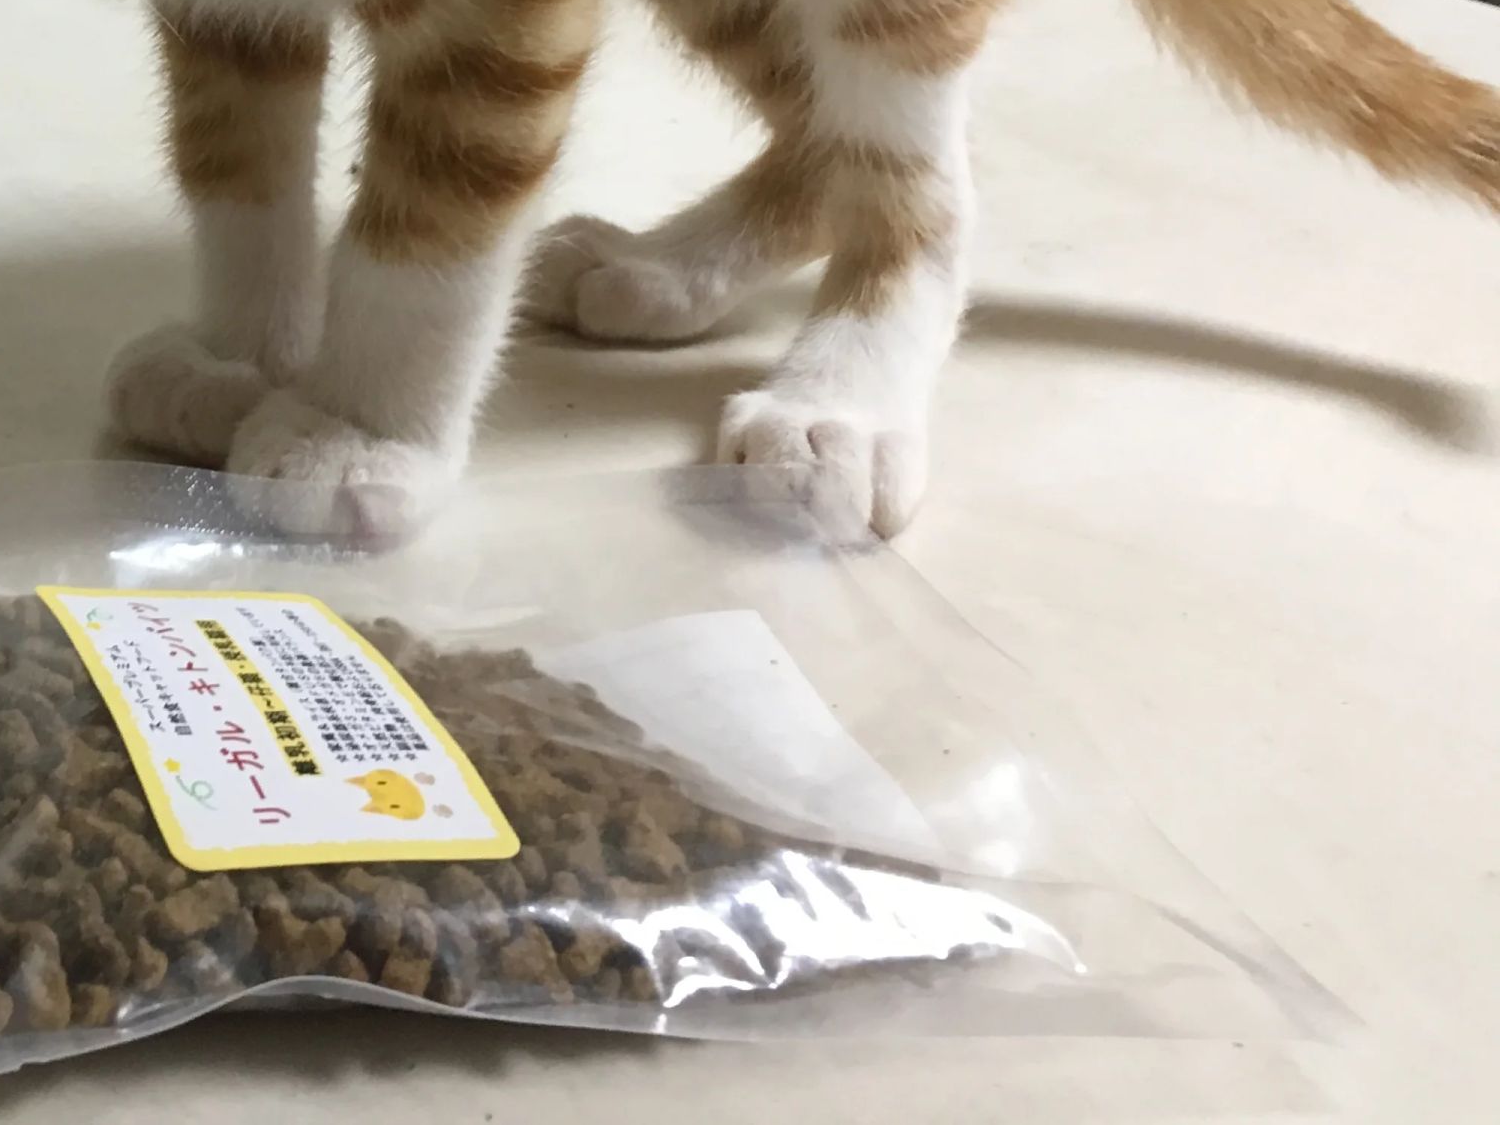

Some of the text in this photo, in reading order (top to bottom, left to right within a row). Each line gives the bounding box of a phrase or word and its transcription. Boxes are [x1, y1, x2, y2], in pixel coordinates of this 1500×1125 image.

[105, 644, 167, 732] スーパープレミアム
[122, 640, 194, 735] 自然食キャットフード
[126, 601, 293, 824] リーガル・キトンバイツ
